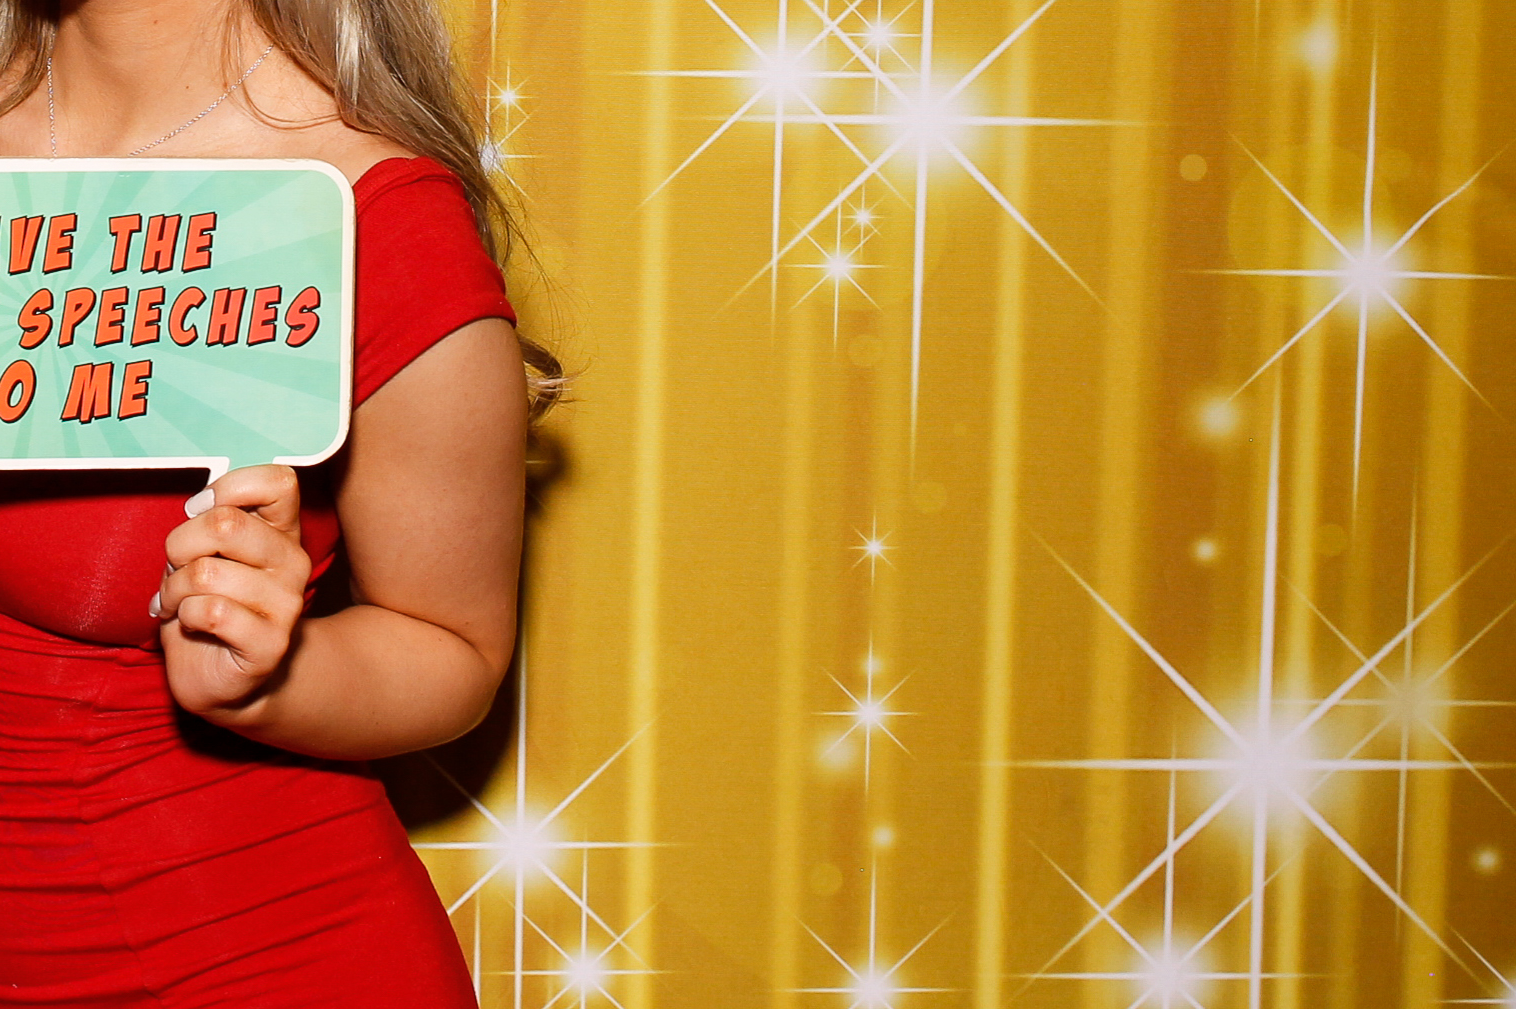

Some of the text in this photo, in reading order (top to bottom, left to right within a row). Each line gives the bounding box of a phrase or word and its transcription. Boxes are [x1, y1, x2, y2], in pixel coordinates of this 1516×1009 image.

[108, 211, 217, 274] THE
[16, 285, 322, 349] SPEECHES
[60, 358, 153, 424] ME
